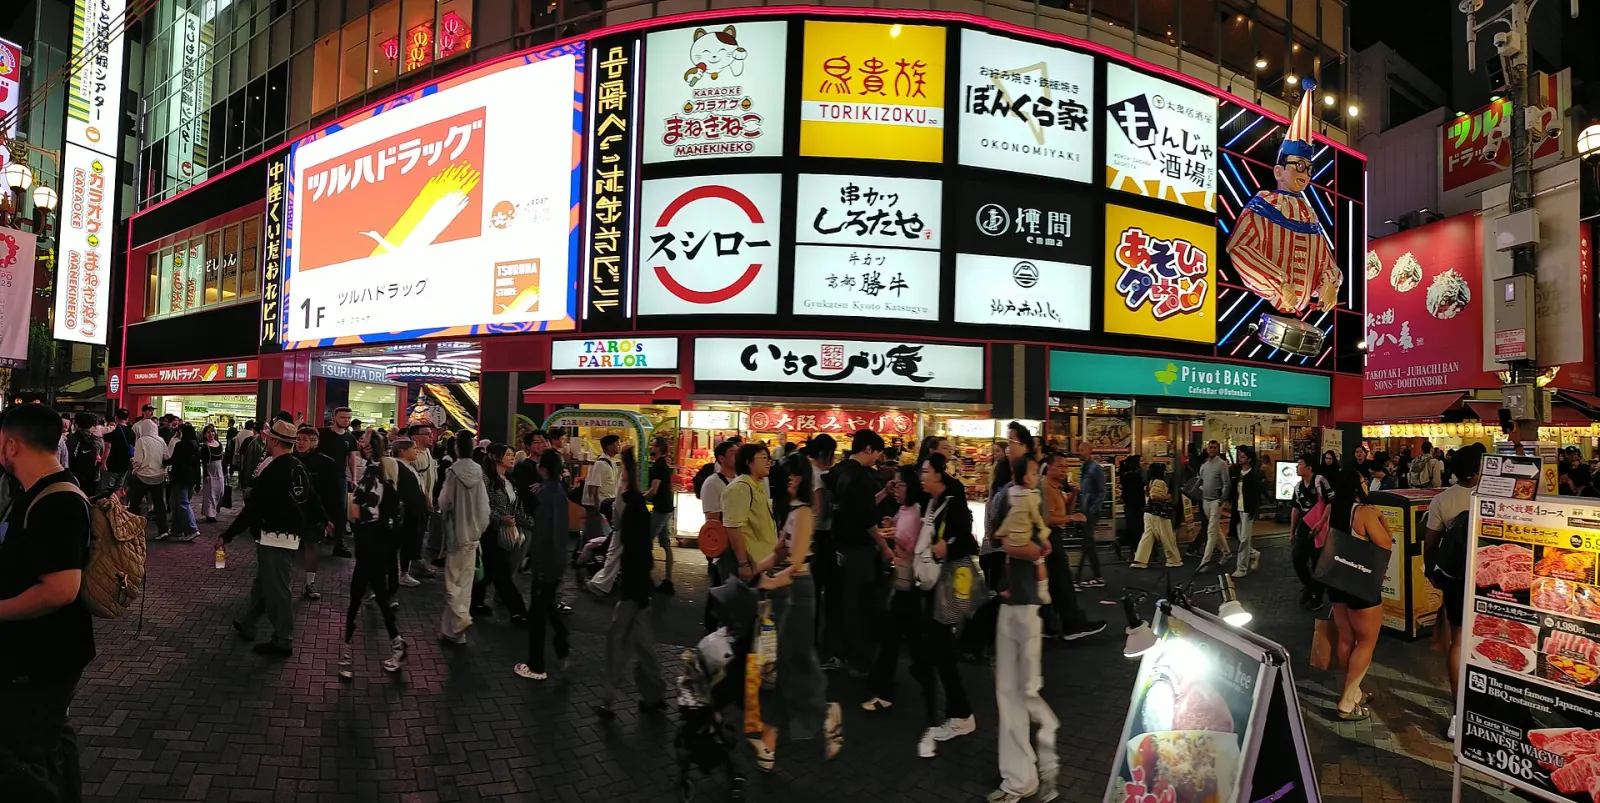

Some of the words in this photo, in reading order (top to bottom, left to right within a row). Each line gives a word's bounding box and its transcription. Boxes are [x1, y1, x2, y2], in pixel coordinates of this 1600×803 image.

[819, 56, 928, 99] 鳥貴族
[979, 66, 1079, 95] お好み焼き・鉄板焼き
[694, 87, 741, 97] KARAOKE
[695, 100, 739, 110] カラオケ
[819, 104, 926, 124] TORIKIZOKU
[965, 84, 1089, 132] ぼんくら家
[663, 114, 761, 145] まねきねこ
[1117, 101, 1213, 161] もんじゃ
[307, 118, 483, 203] ツルハドラッグ
[676, 143, 753, 155] MANEKINEKO
[980, 138, 1080, 162] OKONOMIYAKI
[592, 46, 629, 313] 中座くいだおれビル
[1159, 151, 1206, 188] 酒場
[72, 169, 84, 228] KARAOKE
[87, 173, 104, 234] カラオケ
[840, 182, 899, 207] 串カツ
[813, 207, 925, 239] しろたや
[263, 160, 285, 341] 中座くいだおれビル
[646, 229, 772, 262] スシロー
[1026, 236, 1063, 247] enma
[1117, 228, 1206, 279] あそび
[848, 252, 886, 266] 牛カツ
[66, 252, 80, 329] MANEKINEKO
[82, 251, 100, 336] まねきねこ
[338, 278, 431, 306] ツルハドラッグ
[803, 299, 848, 310] Gyukatsu
[852, 301, 881, 311] Kyoto
[884, 302, 929, 314] Katsugyu
[578, 354, 648, 367] PARLOR
[583, 340, 644, 353] TARO's
[159, 368, 201, 381] ツルハドラッグ
[225, 364, 234, 378] 薬
[320, 363, 367, 381] TSURUHA
[772, 413, 893, 434] 大阪みやげ
[1487, 686, 1511, 703] BBQ
[1509, 695, 1552, 714] restaurant.
[1488, 676, 1503, 689] The
[1504, 684, 1523, 695] most
[1523, 688, 1555, 704] famous
[1554, 697, 1593, 716] Japanese
[1483, 719, 1501, 730] carte
[1502, 725, 1520, 737] Menu
[1466, 723, 1519, 752] JAPANESE
[1520, 742, 1565, 768] WAGYU
